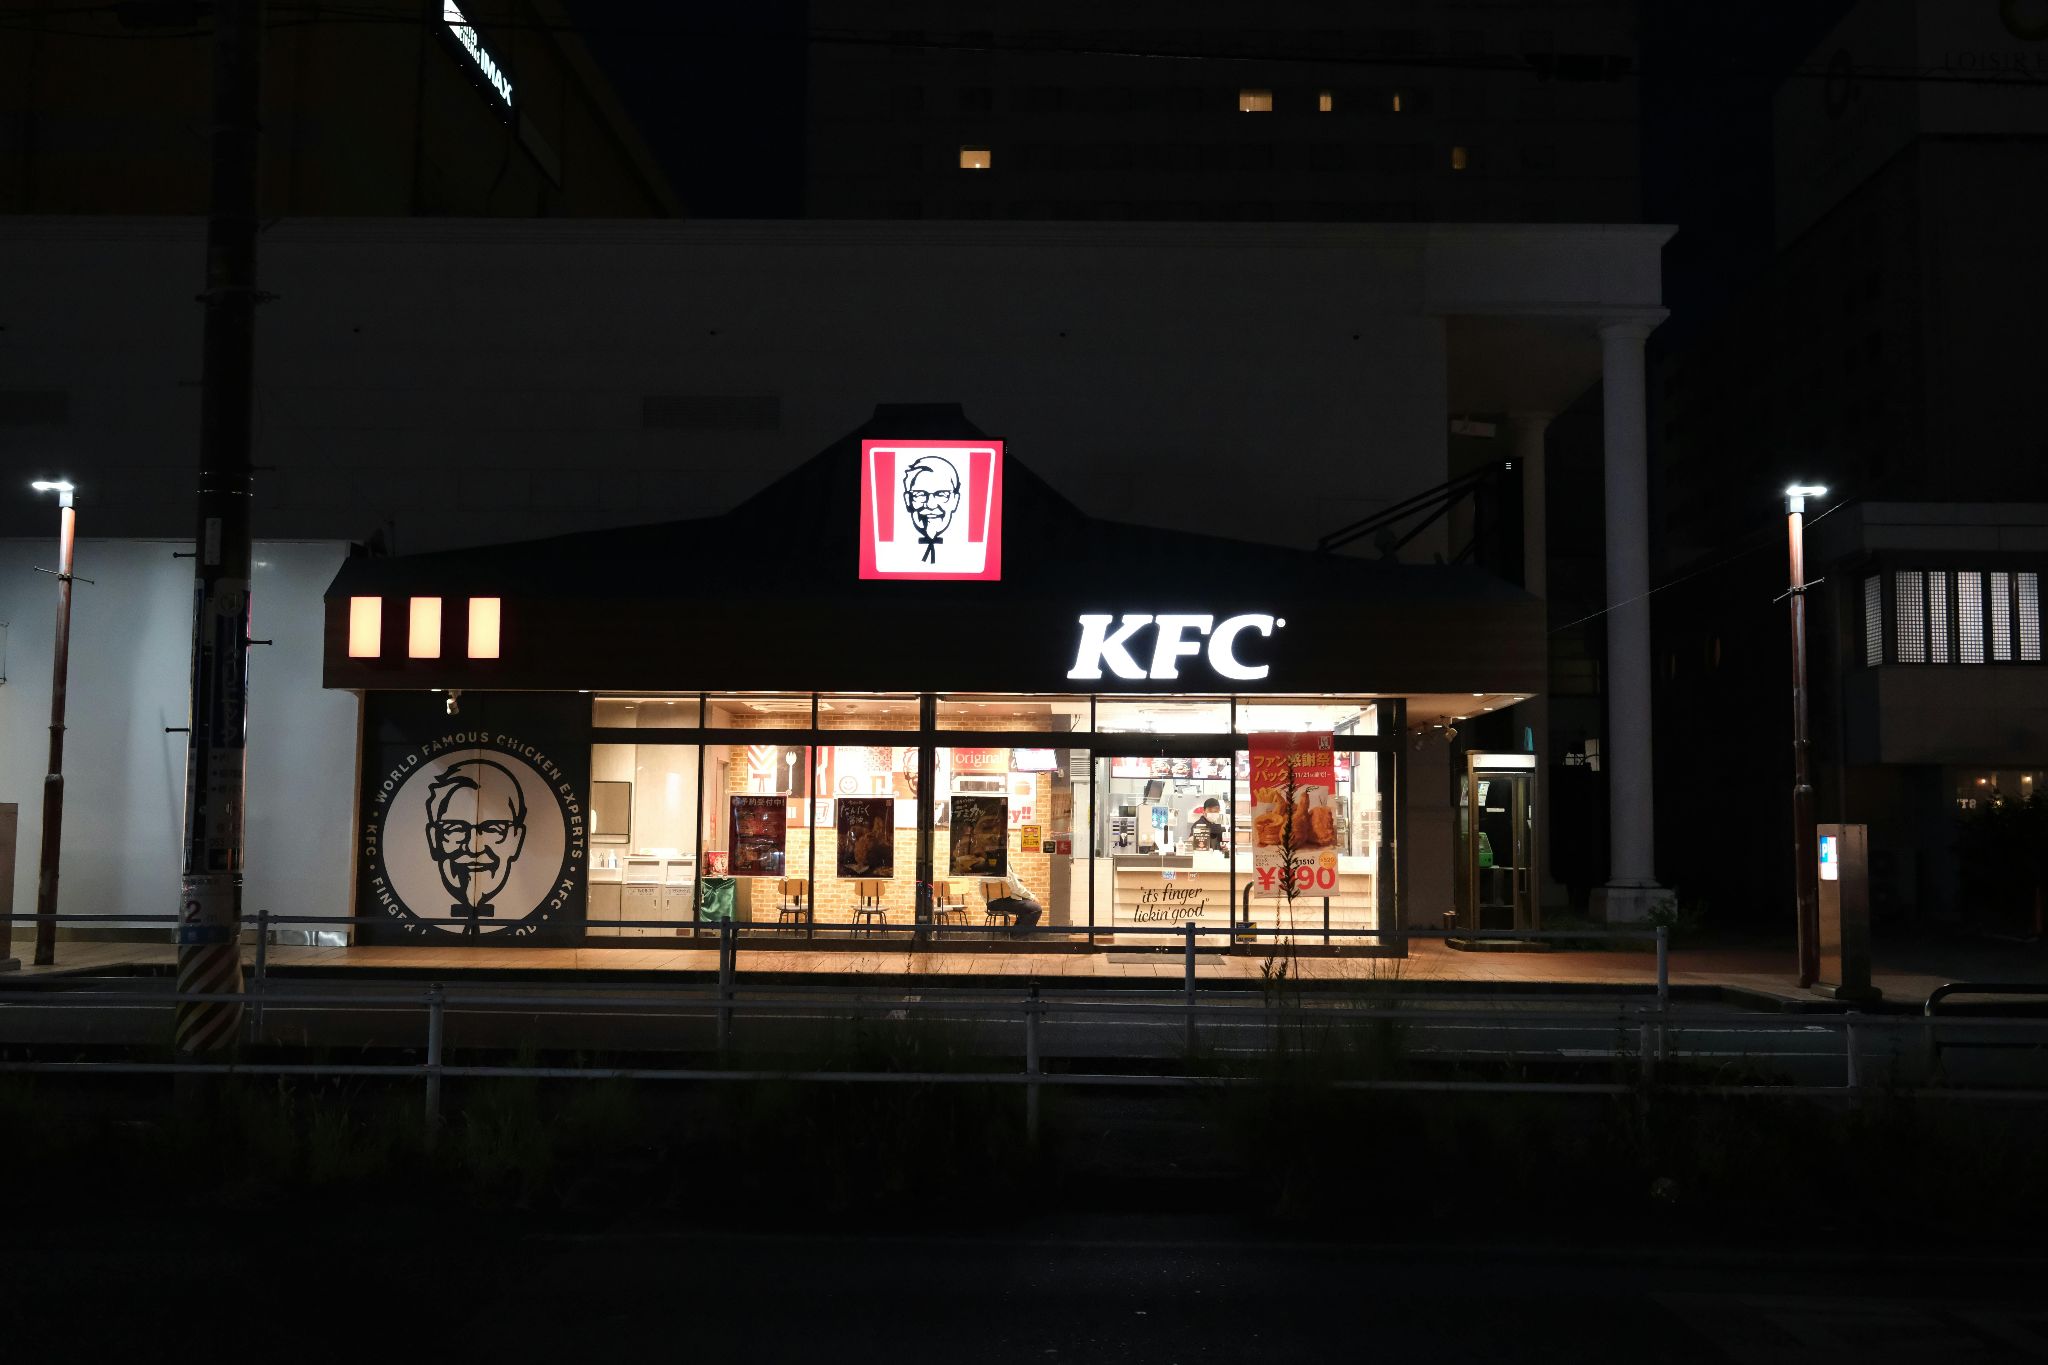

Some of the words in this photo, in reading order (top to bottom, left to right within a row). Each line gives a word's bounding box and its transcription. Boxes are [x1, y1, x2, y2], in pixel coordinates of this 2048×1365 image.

[480, 47, 512, 107] IMAX
[1944, 52, 2027, 71] LOISIR
[1066, 613, 1275, 680] KFC
[1253, 752, 1332, 768] ファン感謝祭
[375, 754, 418, 804] WORLD
[421, 731, 489, 755] FAMOUS
[496, 733, 563, 781] CHICKEN
[559, 783, 583, 859] EXPERTS
[365, 823, 378, 857] KFC
[550, 878, 574, 910] KFC
[1162, 882, 1203, 906] finger
[185, 900, 201, 924] 2
